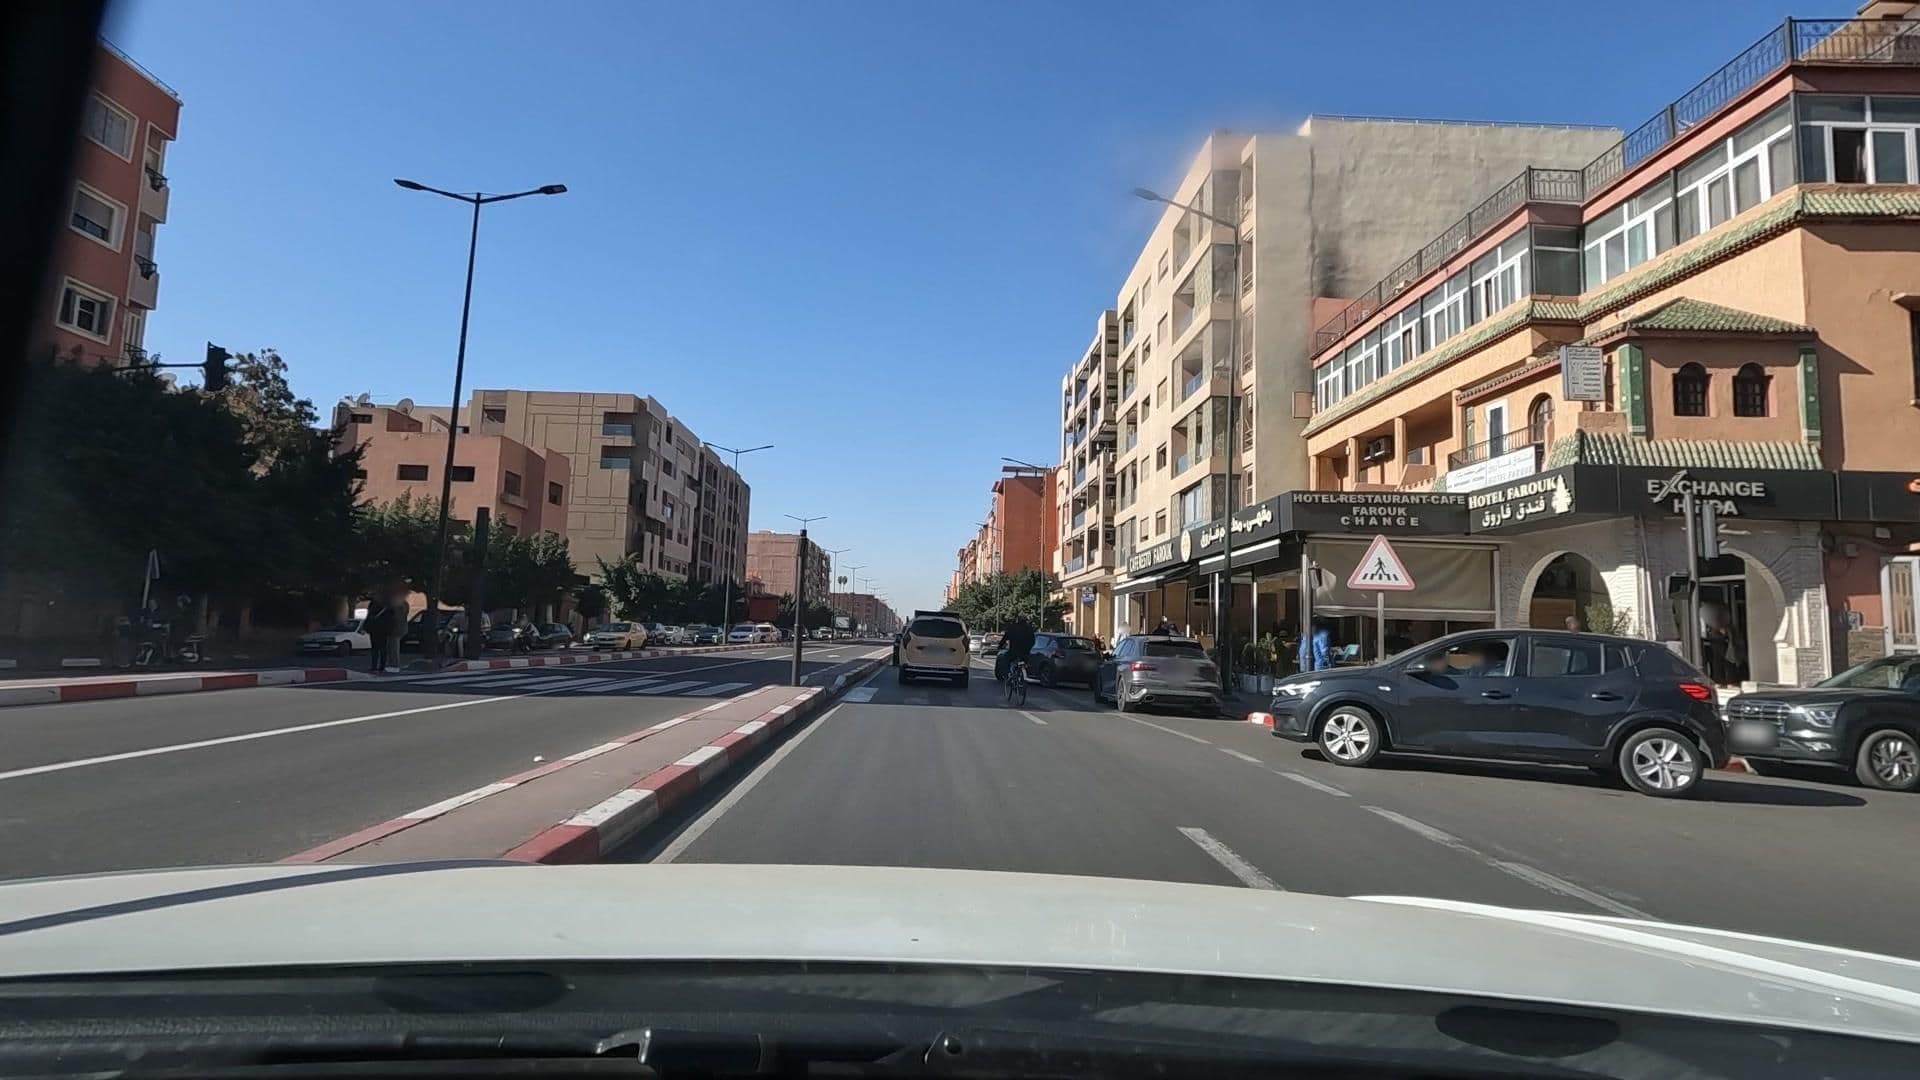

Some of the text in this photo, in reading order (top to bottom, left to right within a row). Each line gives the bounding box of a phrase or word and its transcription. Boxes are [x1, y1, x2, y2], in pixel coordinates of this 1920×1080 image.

[1468, 491, 1505, 510] HOTEL
[1506, 476, 1558, 500] FAROUK
[1647, 474, 1765, 499] EXCHANGE
[1340, 516, 1420, 526] CHANGE
[1352, 506, 1408, 516] FAROUK
[1482, 495, 1546, 527] فندق فاروق
